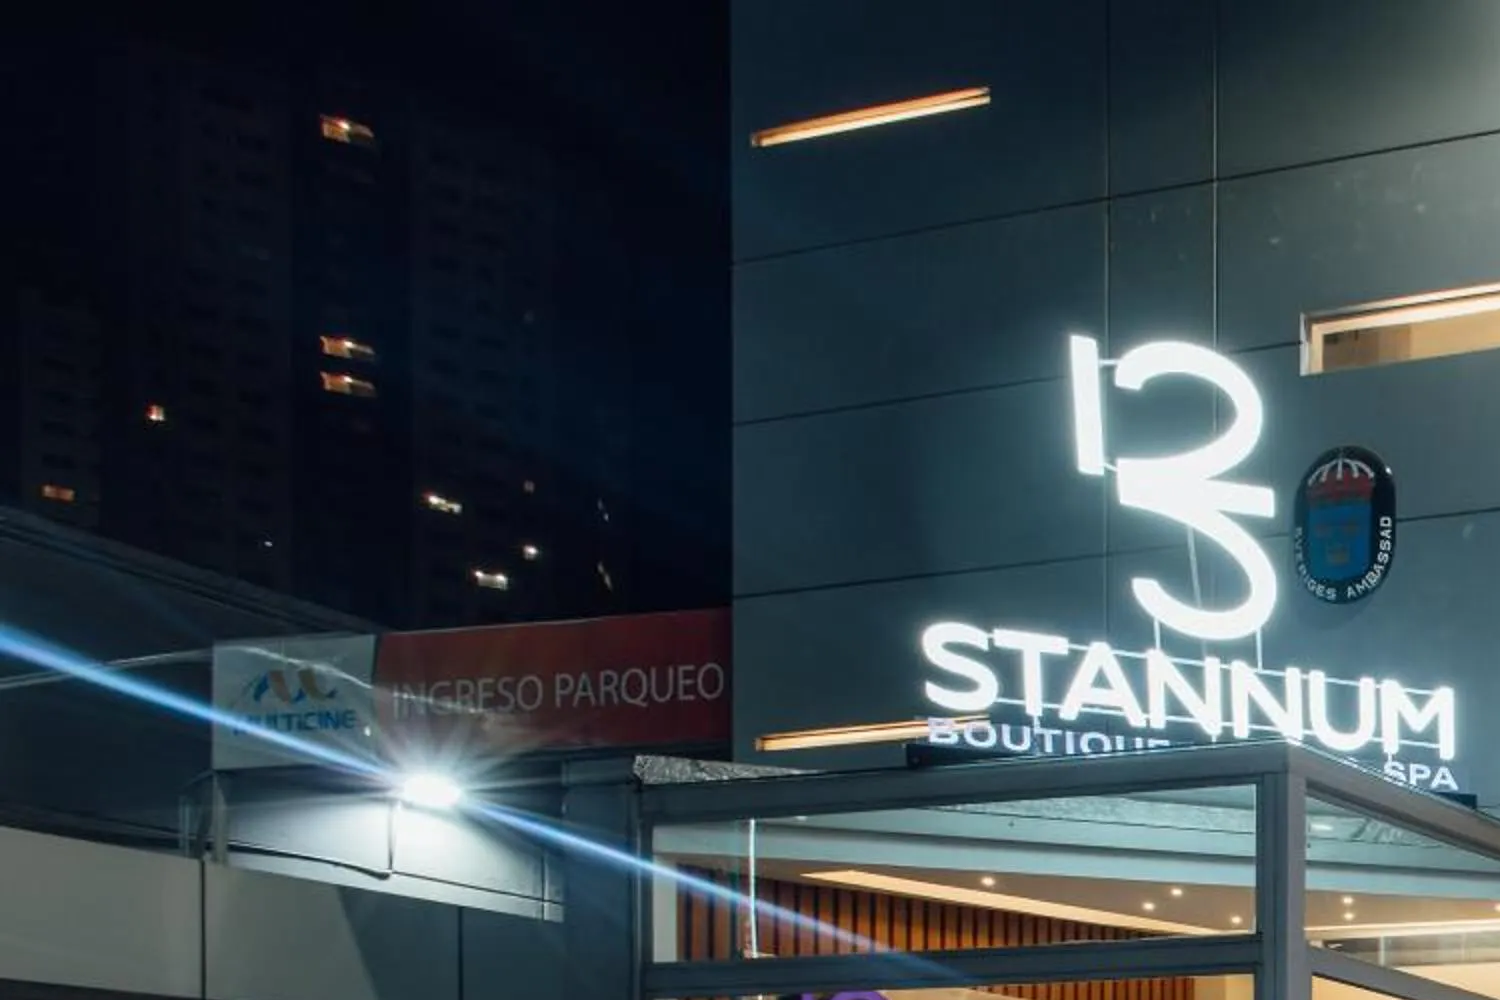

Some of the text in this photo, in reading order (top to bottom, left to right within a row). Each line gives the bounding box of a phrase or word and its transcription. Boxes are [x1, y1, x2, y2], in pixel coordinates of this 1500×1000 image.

[1347, 516, 1392, 599] AMBASSAD
[391, 661, 726, 719] INGRESO PARQUEO
[920, 621, 1457, 761] STANNUM
[927, 717, 1460, 791] BOUTIQU SPA
